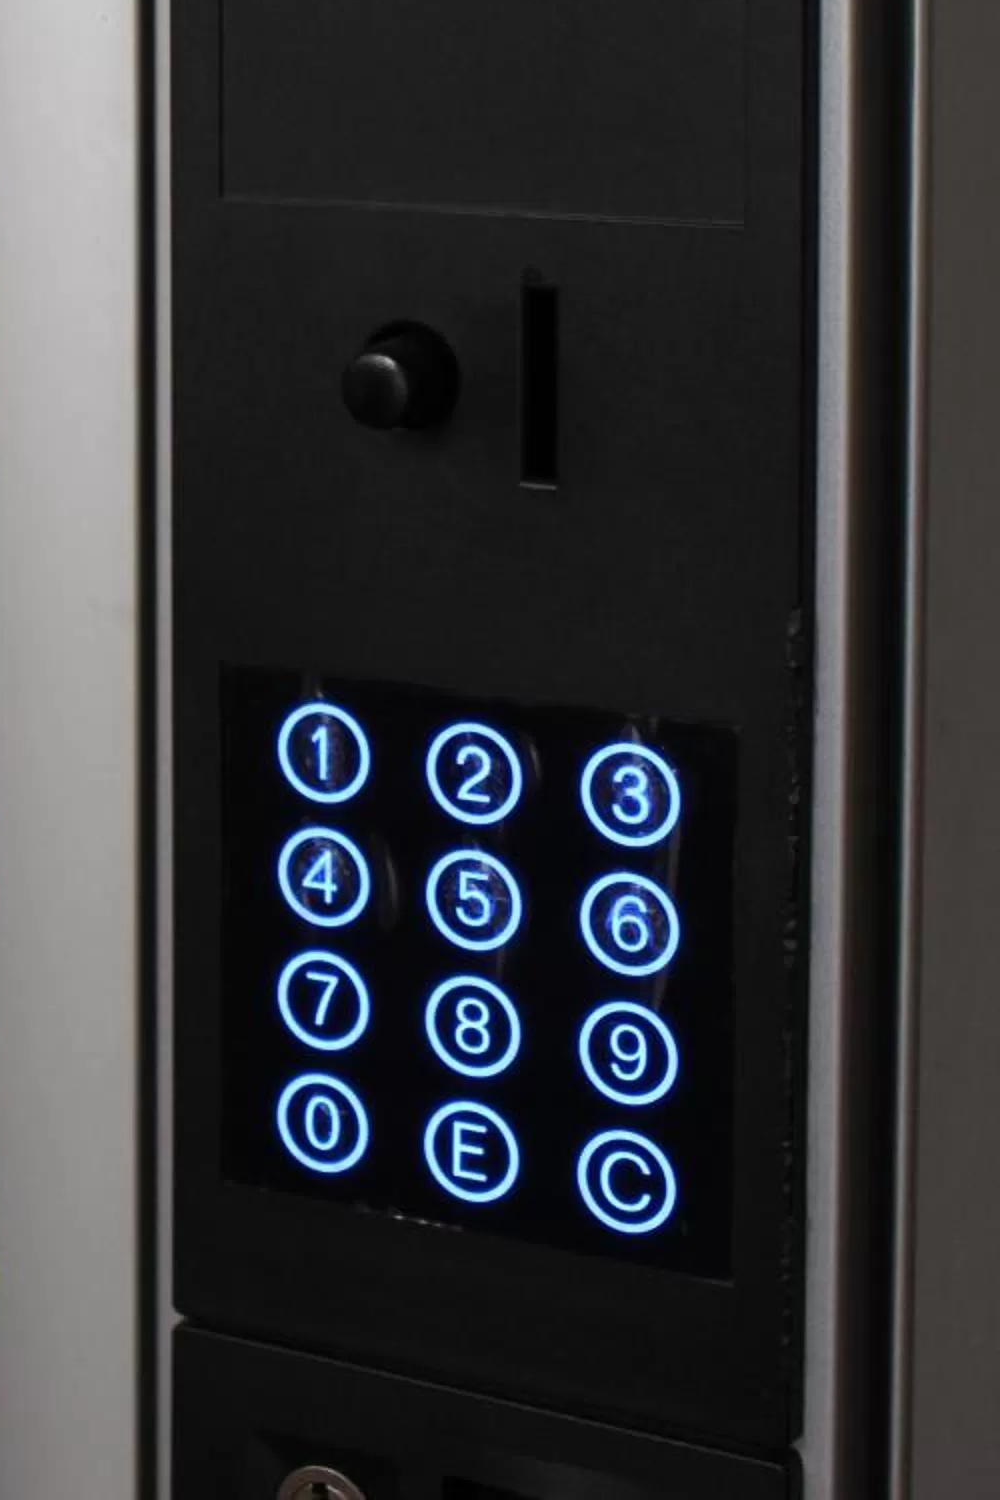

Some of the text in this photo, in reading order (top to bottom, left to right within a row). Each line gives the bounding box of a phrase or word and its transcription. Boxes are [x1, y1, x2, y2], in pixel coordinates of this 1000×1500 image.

[311, 725, 329, 781] 1
[456, 744, 492, 803] 2
[612, 763, 651, 825] 3
[301, 848, 338, 904] 4
[455, 870, 492, 927] 5
[609, 894, 650, 953] 6
[306, 971, 339, 1026] 7
[455, 997, 491, 1055] 8
[610, 1023, 647, 1081] 9
[305, 1095, 341, 1151] 0
[452, 1120, 488, 1182] E
[599, 1151, 651, 1213] C
